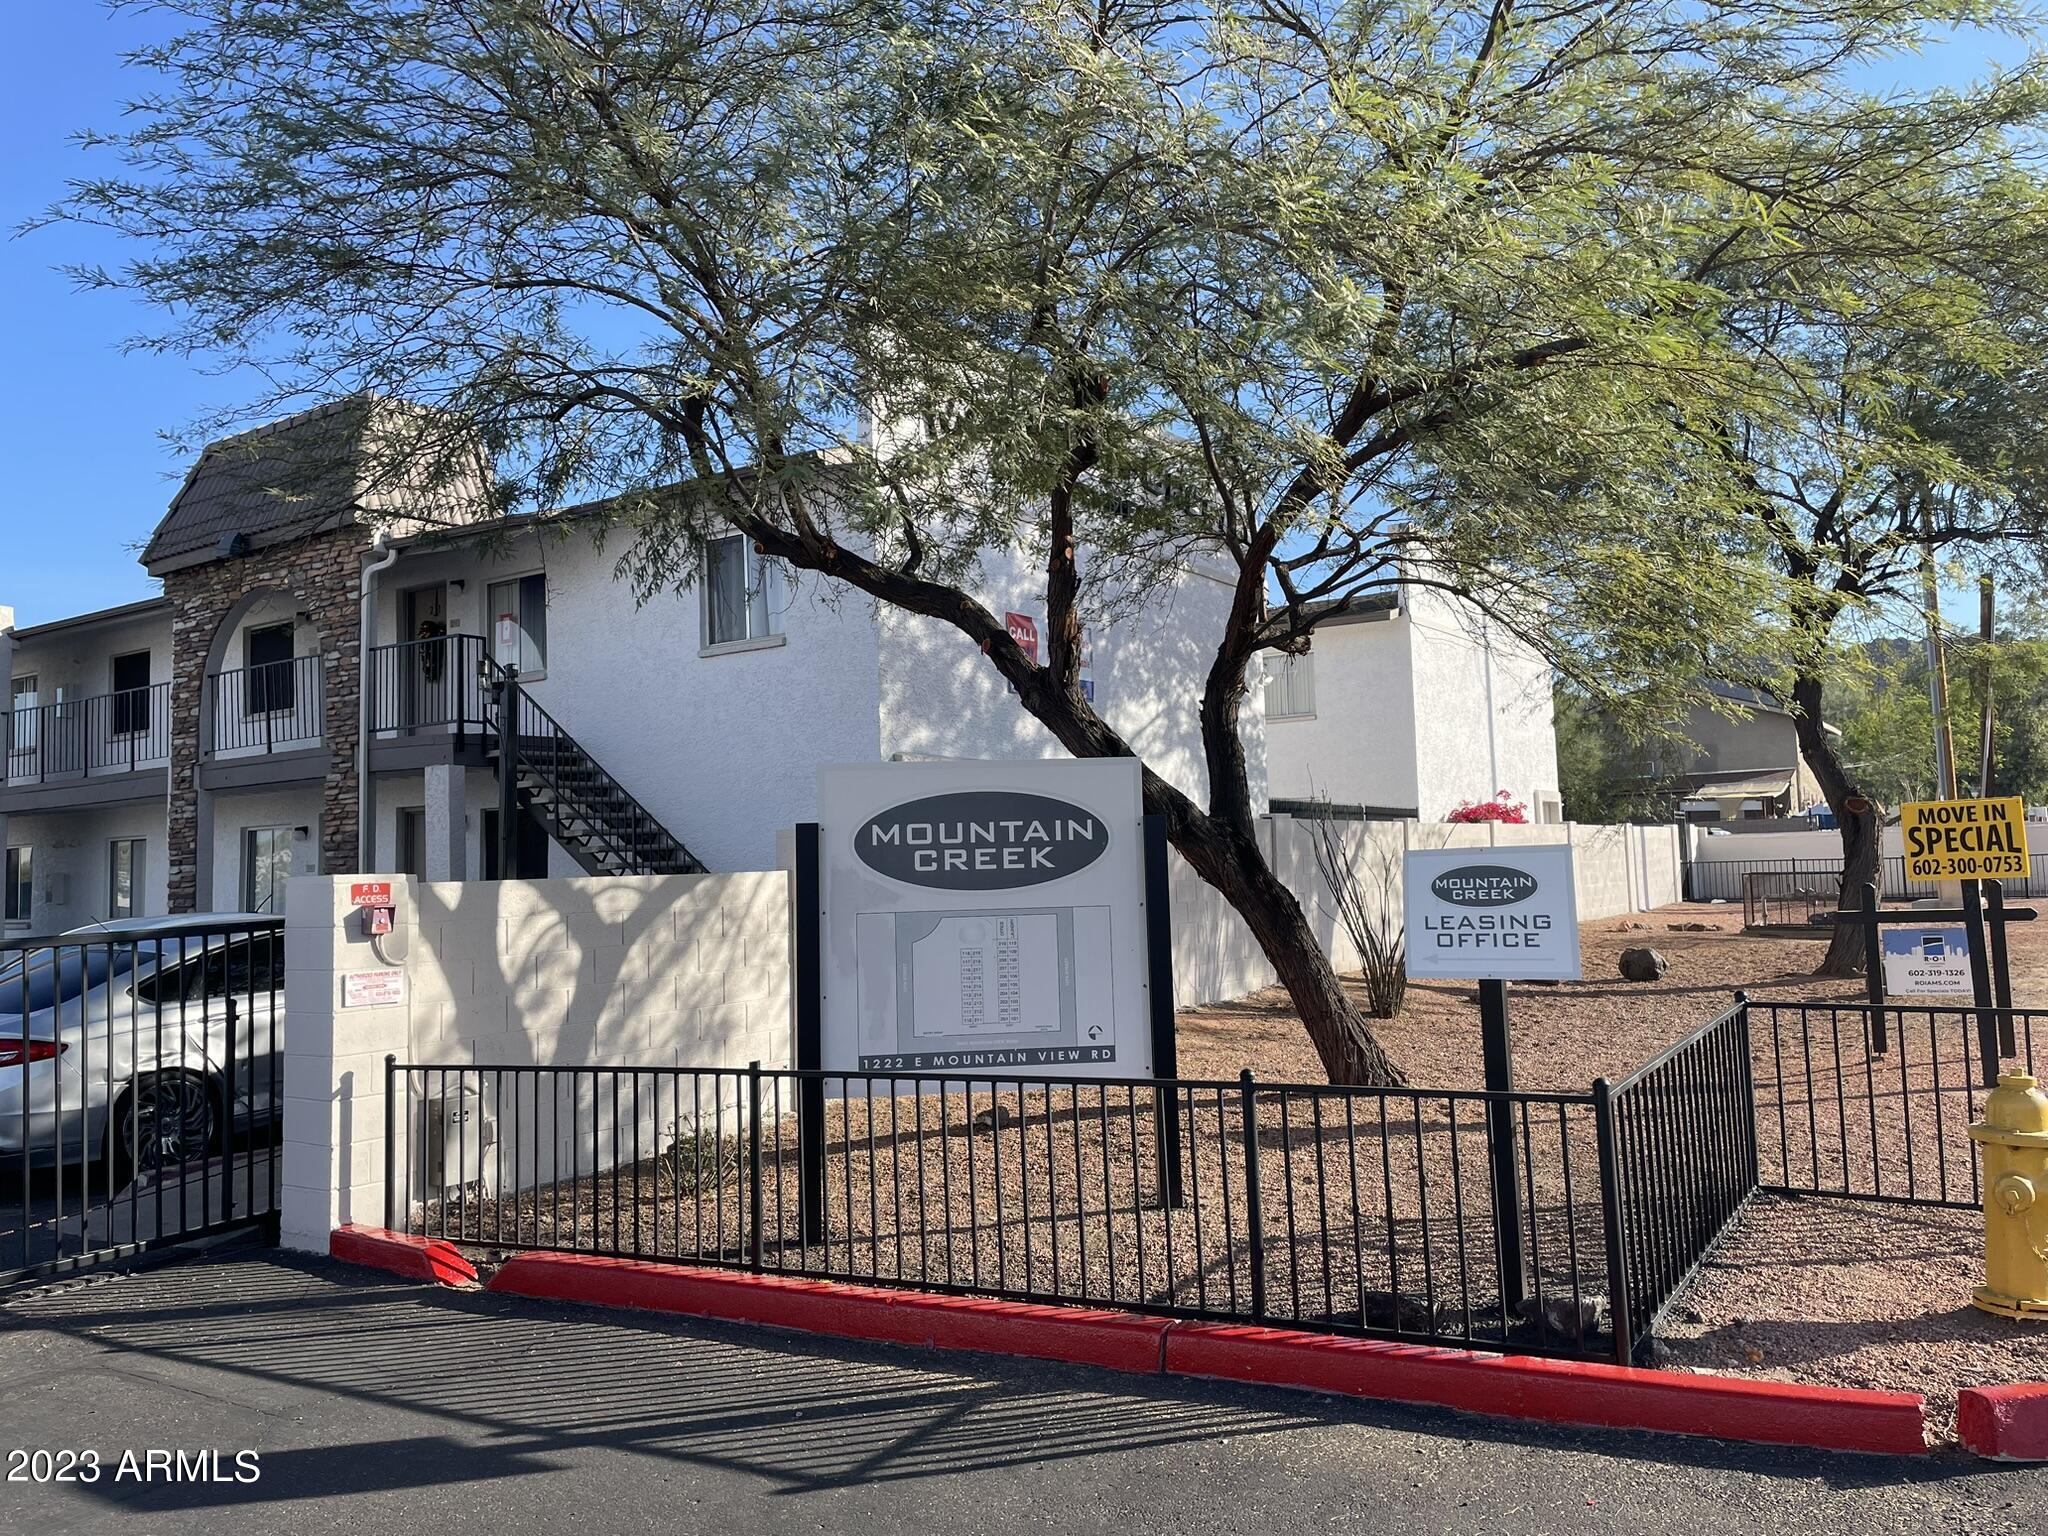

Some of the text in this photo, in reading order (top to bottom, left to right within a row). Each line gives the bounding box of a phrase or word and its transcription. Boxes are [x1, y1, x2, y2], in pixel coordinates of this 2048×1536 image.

[1009, 626, 1035, 642] CALL
[1918, 803, 2006, 825] MOVE IN
[871, 819, 1093, 846] MOUNTAIN
[1908, 823, 2022, 858] SPECIAL
[914, 846, 1056, 872] CREEK
[1912, 855, 2023, 876] 602-300-0753
[1435, 876, 1532, 889] MOUNTAIN
[353, 894, 389, 904] ACCESS
[1452, 888, 1516, 900] CREEK
[1424, 914, 1551, 930] LEASING
[1437, 932, 1541, 948] OFFICE
[1908, 969, 1965, 977] 602-319-1326
[863, 1048, 1112, 1070] 1222 E MOUNTAIN VIEW RD
